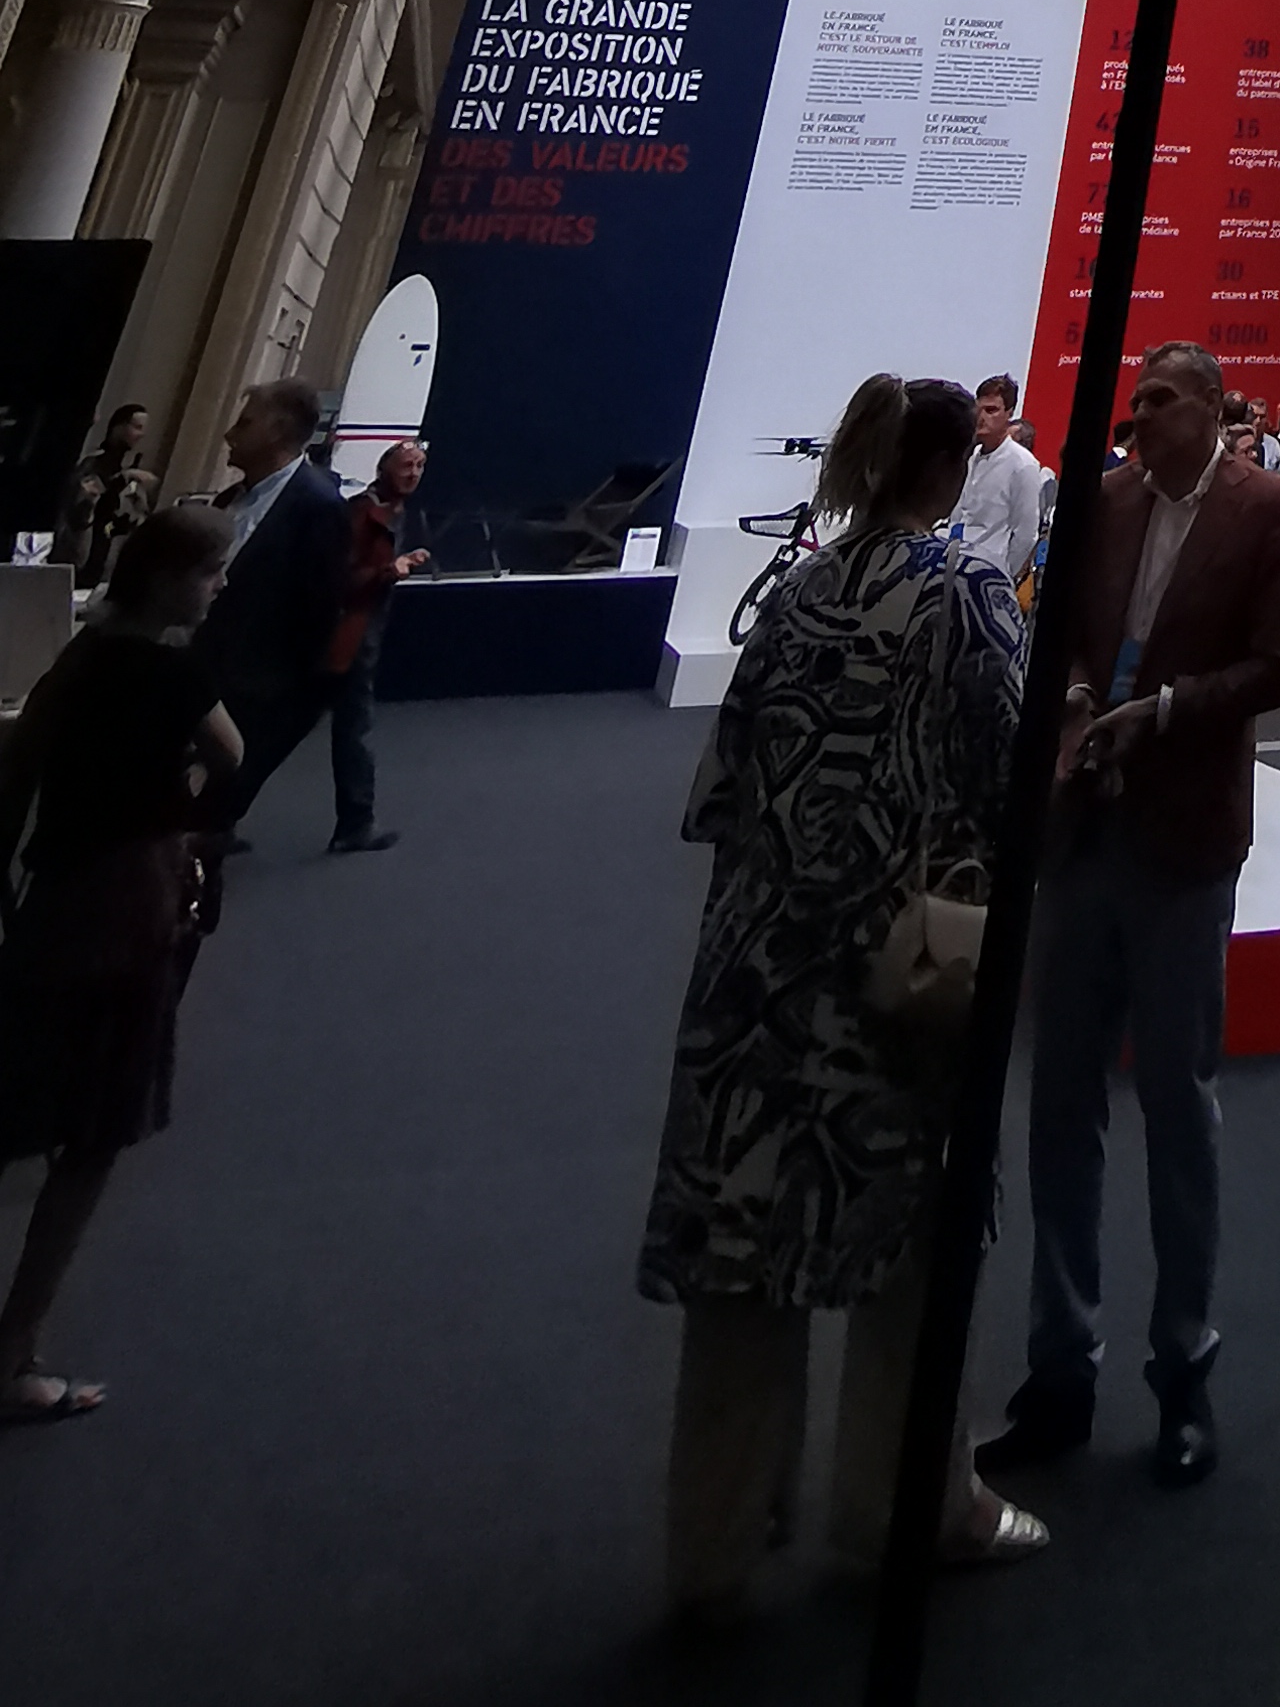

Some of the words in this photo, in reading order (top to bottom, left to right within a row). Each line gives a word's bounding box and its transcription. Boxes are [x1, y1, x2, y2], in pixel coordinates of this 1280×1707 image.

[821, 22, 835, 30] EN
[942, 28, 955, 36] EN
[471, 28, 683, 65] EXPOSITION
[461, 64, 515, 93] DU
[527, 66, 703, 104] FABRIQUÉ
[1238, 78, 1250, 87] du
[1236, 89, 1248, 97] du
[450, 99, 505, 131] EN
[516, 101, 664, 136] FRANCE
[800, 124, 814, 132] EN
[440, 139, 514, 168] DES
[531, 141, 690, 173] VALEURS
[429, 174, 478, 204] ET
[490, 176, 564, 207] DES
[418, 213, 598, 246] CHIFFRES
[1236, 227, 1267, 239] France
[1261, 290, 1280, 300] TPE
